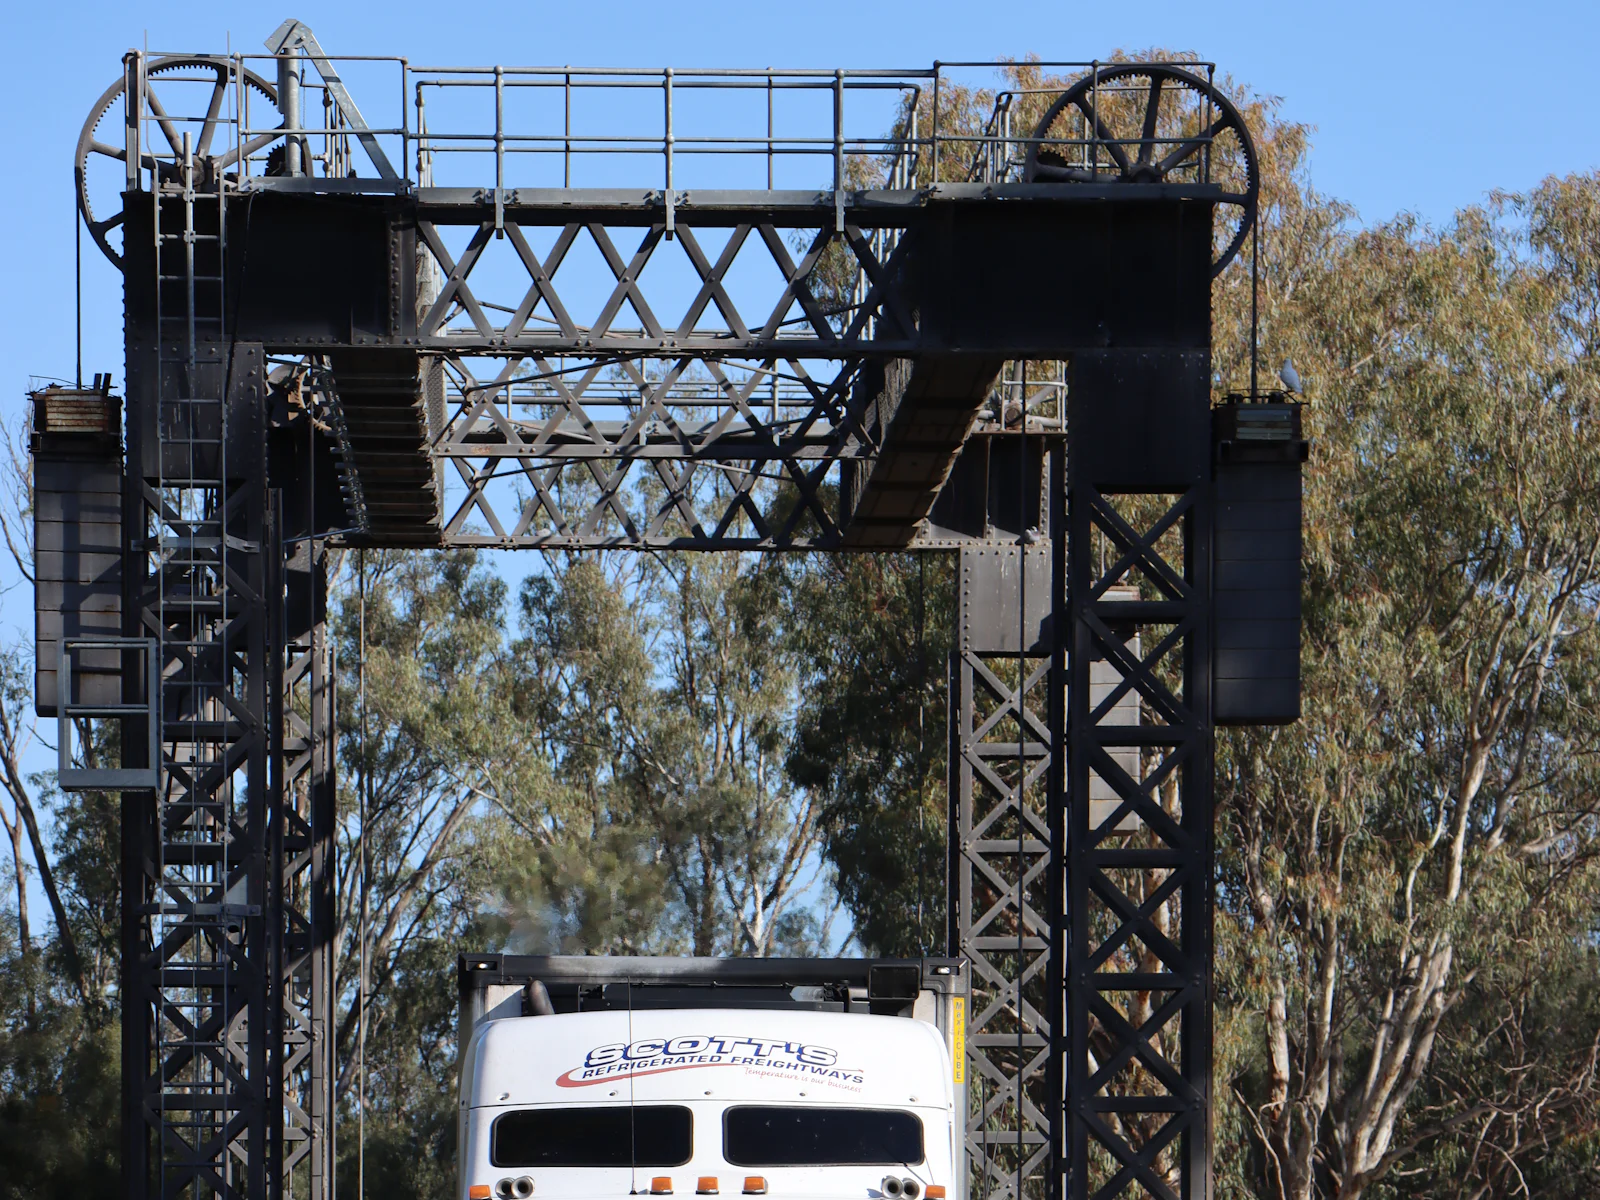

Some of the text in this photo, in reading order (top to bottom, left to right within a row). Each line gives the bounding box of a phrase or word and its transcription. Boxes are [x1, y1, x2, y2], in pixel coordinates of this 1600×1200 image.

[584, 1035, 838, 1068] SCOTT'S
[582, 1054, 864, 1084] REFRIGERATED FREIGHTWAYS
[743, 1066, 799, 1080] Temperature
[811, 1077, 824, 1085] our
[827, 1079, 861, 1093] business
